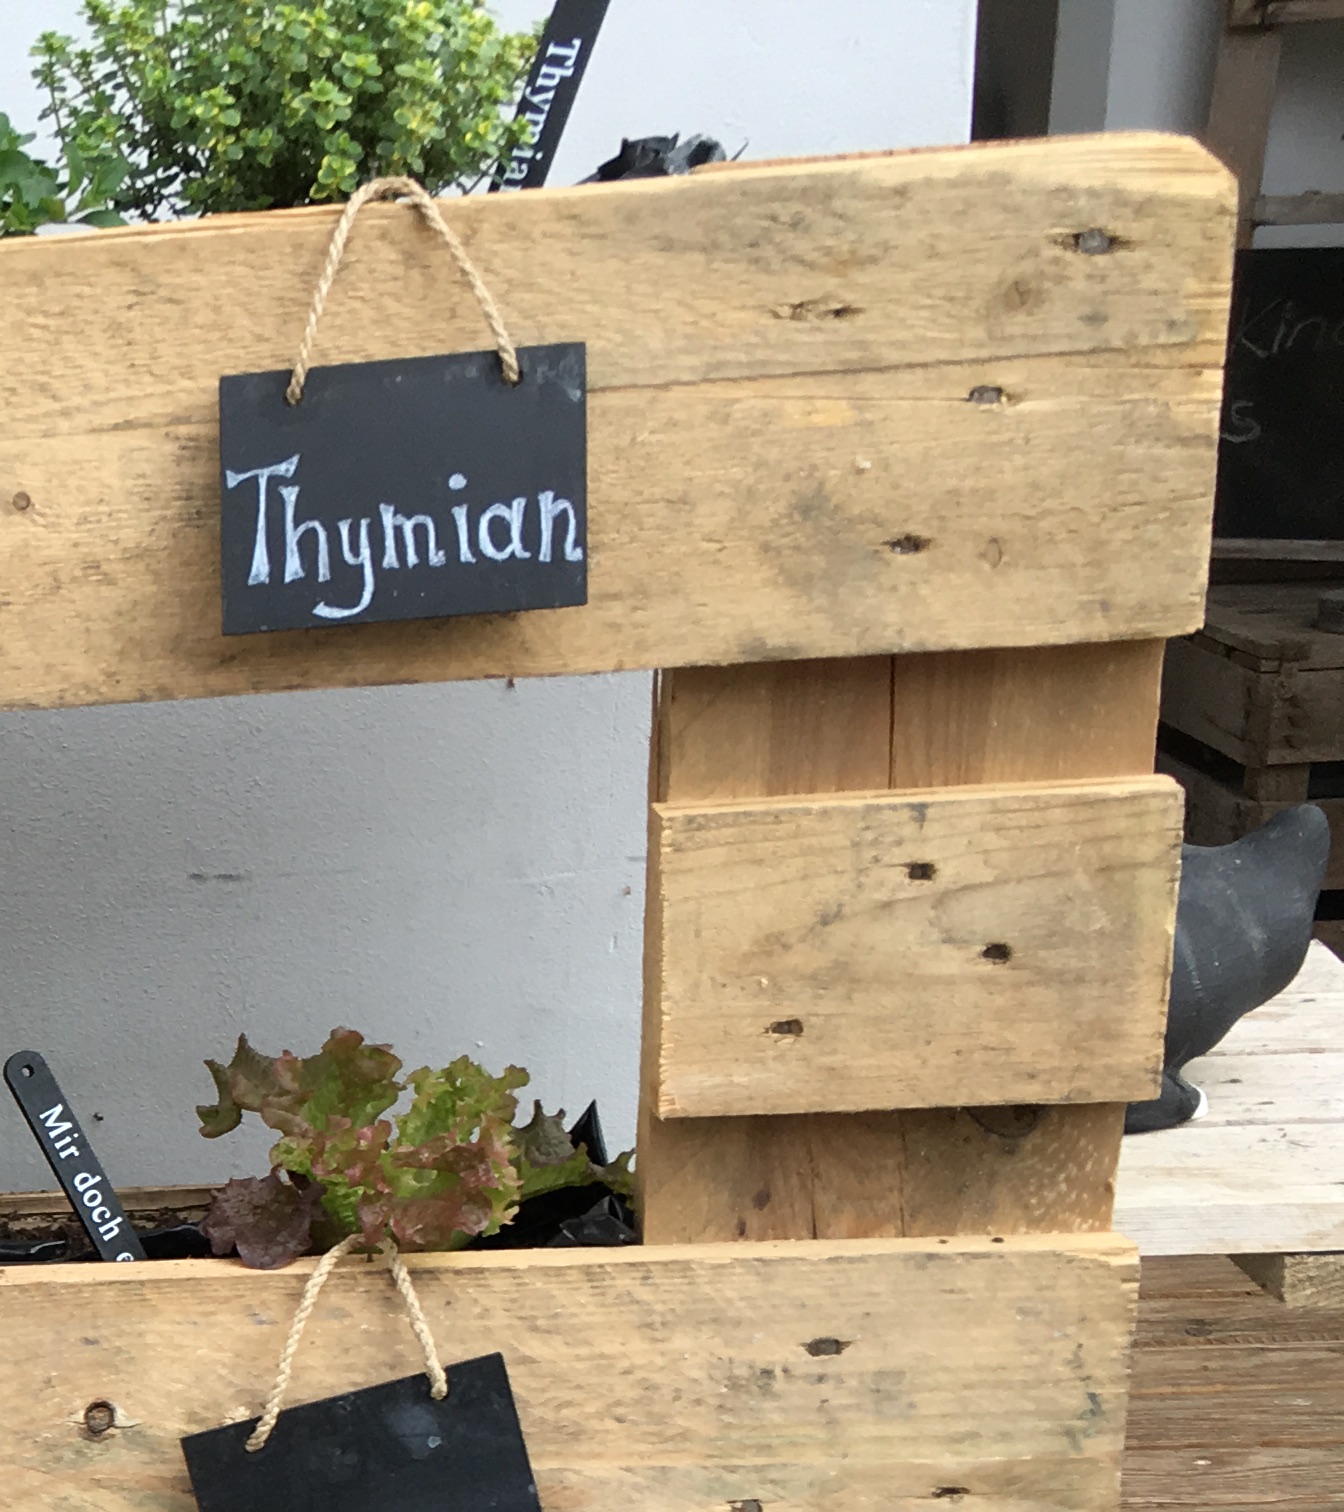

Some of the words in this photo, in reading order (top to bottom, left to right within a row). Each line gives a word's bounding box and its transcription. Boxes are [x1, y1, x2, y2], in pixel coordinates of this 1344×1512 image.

[225, 453, 584, 619] Thymian
[39, 1103, 80, 1160] Mir
[72, 1171, 124, 1242] doch
